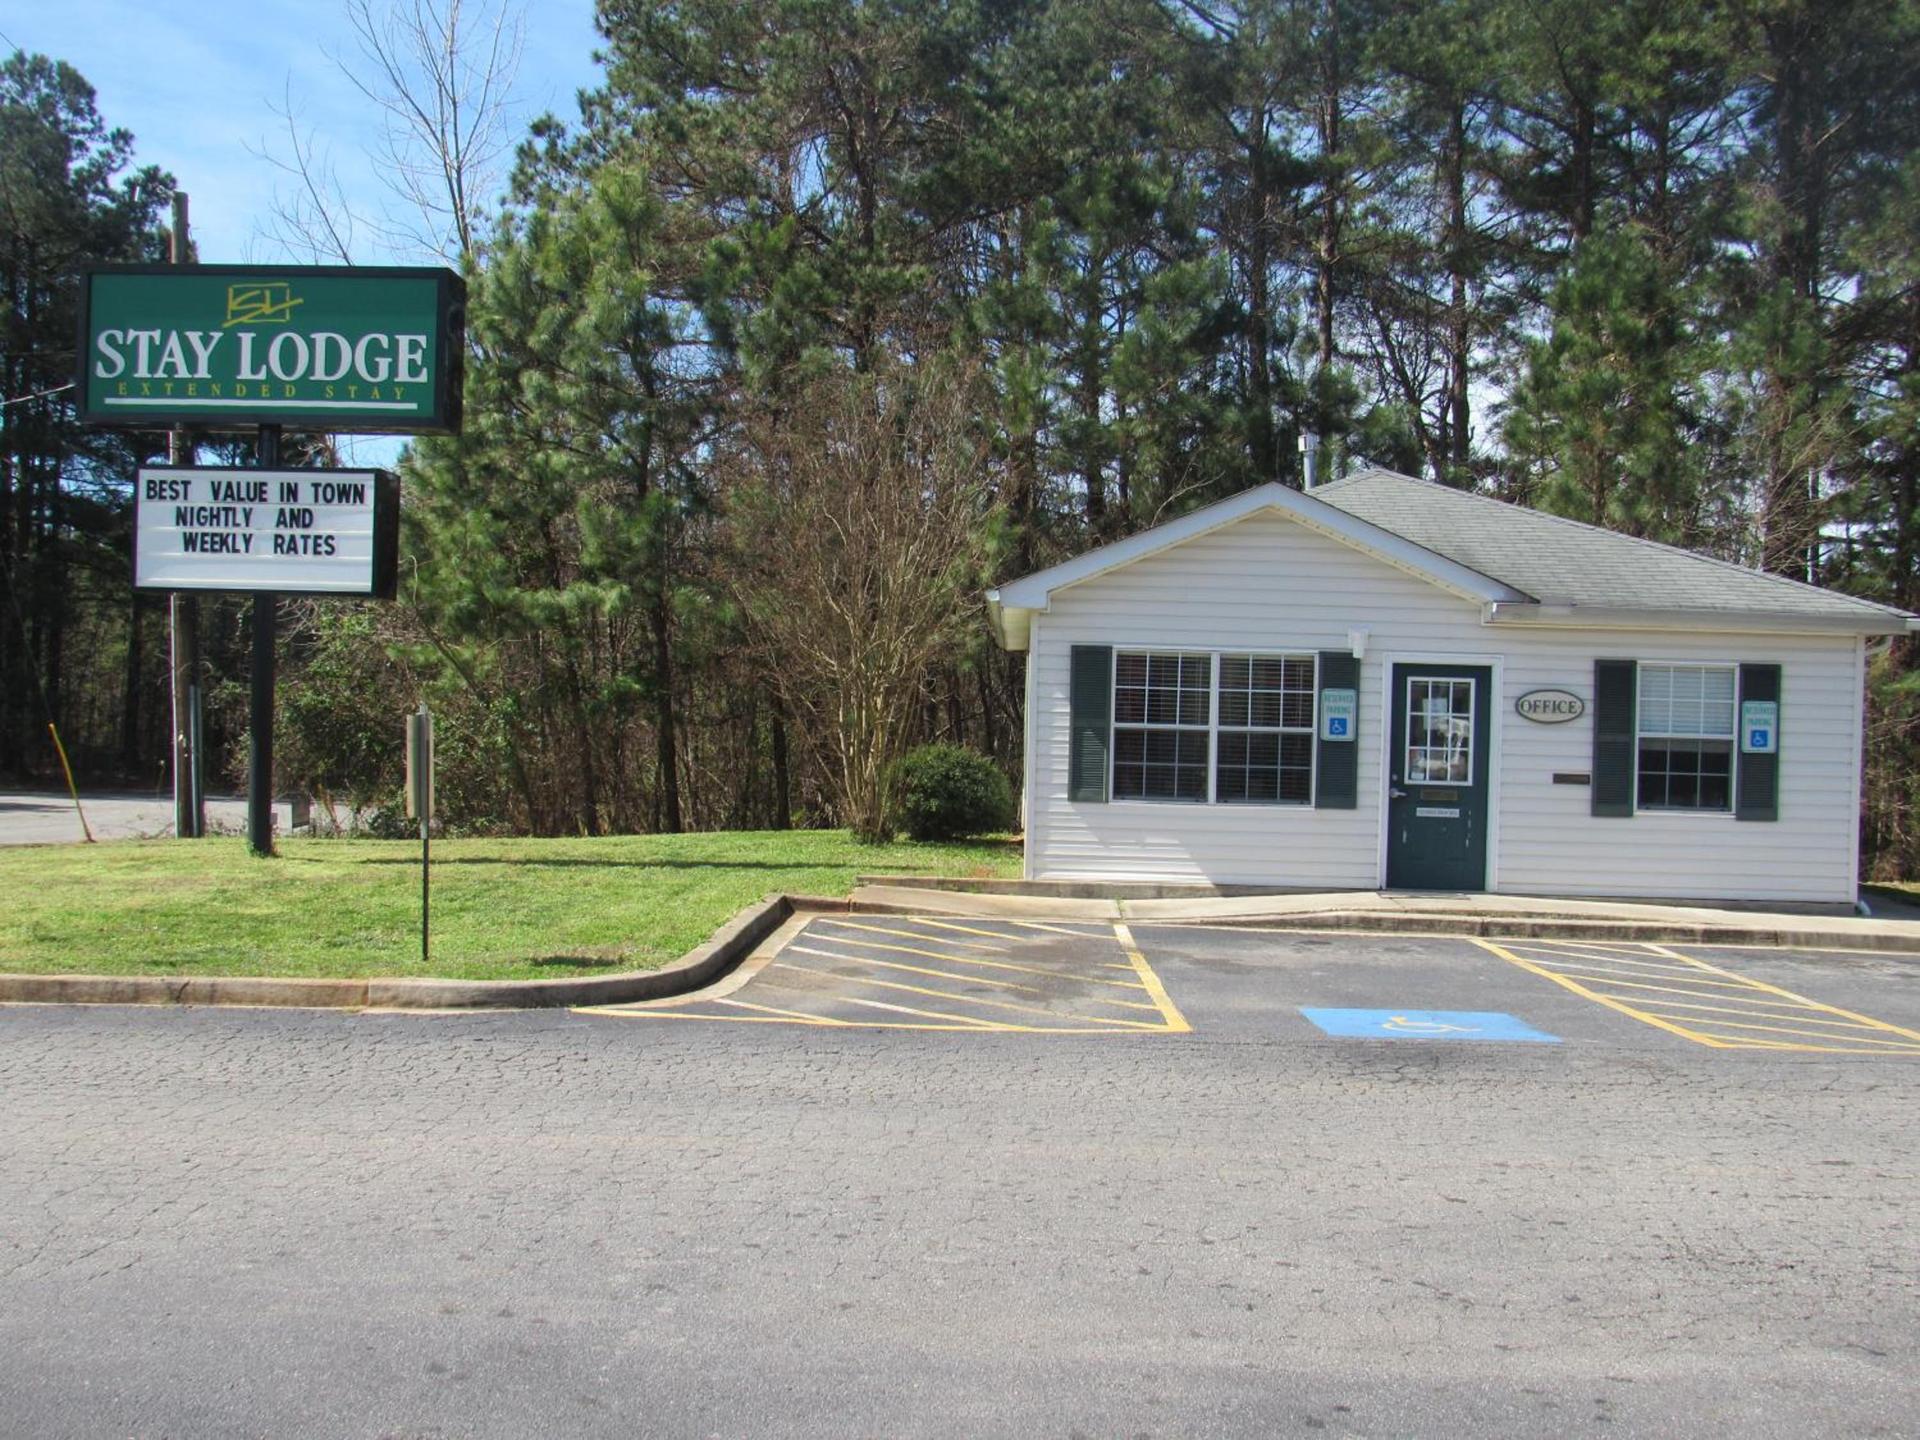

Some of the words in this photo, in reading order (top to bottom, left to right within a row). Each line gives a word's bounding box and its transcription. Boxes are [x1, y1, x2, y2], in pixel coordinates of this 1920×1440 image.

[95, 329, 224, 379] STAY
[236, 332, 428, 384] LODGE
[117, 382, 296, 398] EXTENDED
[325, 386, 406, 400] STAY
[146, 480, 191, 500] BEST
[211, 481, 268, 502] VALUE
[280, 483, 298, 503] IN
[311, 483, 365, 504] TOWN
[176, 507, 253, 528] NIGHTLY
[276, 508, 314, 529] AND
[183, 532, 253, 554] WEEKLY
[273, 535, 336, 556] RATES
[1520, 699, 1578, 714] OFFICE
